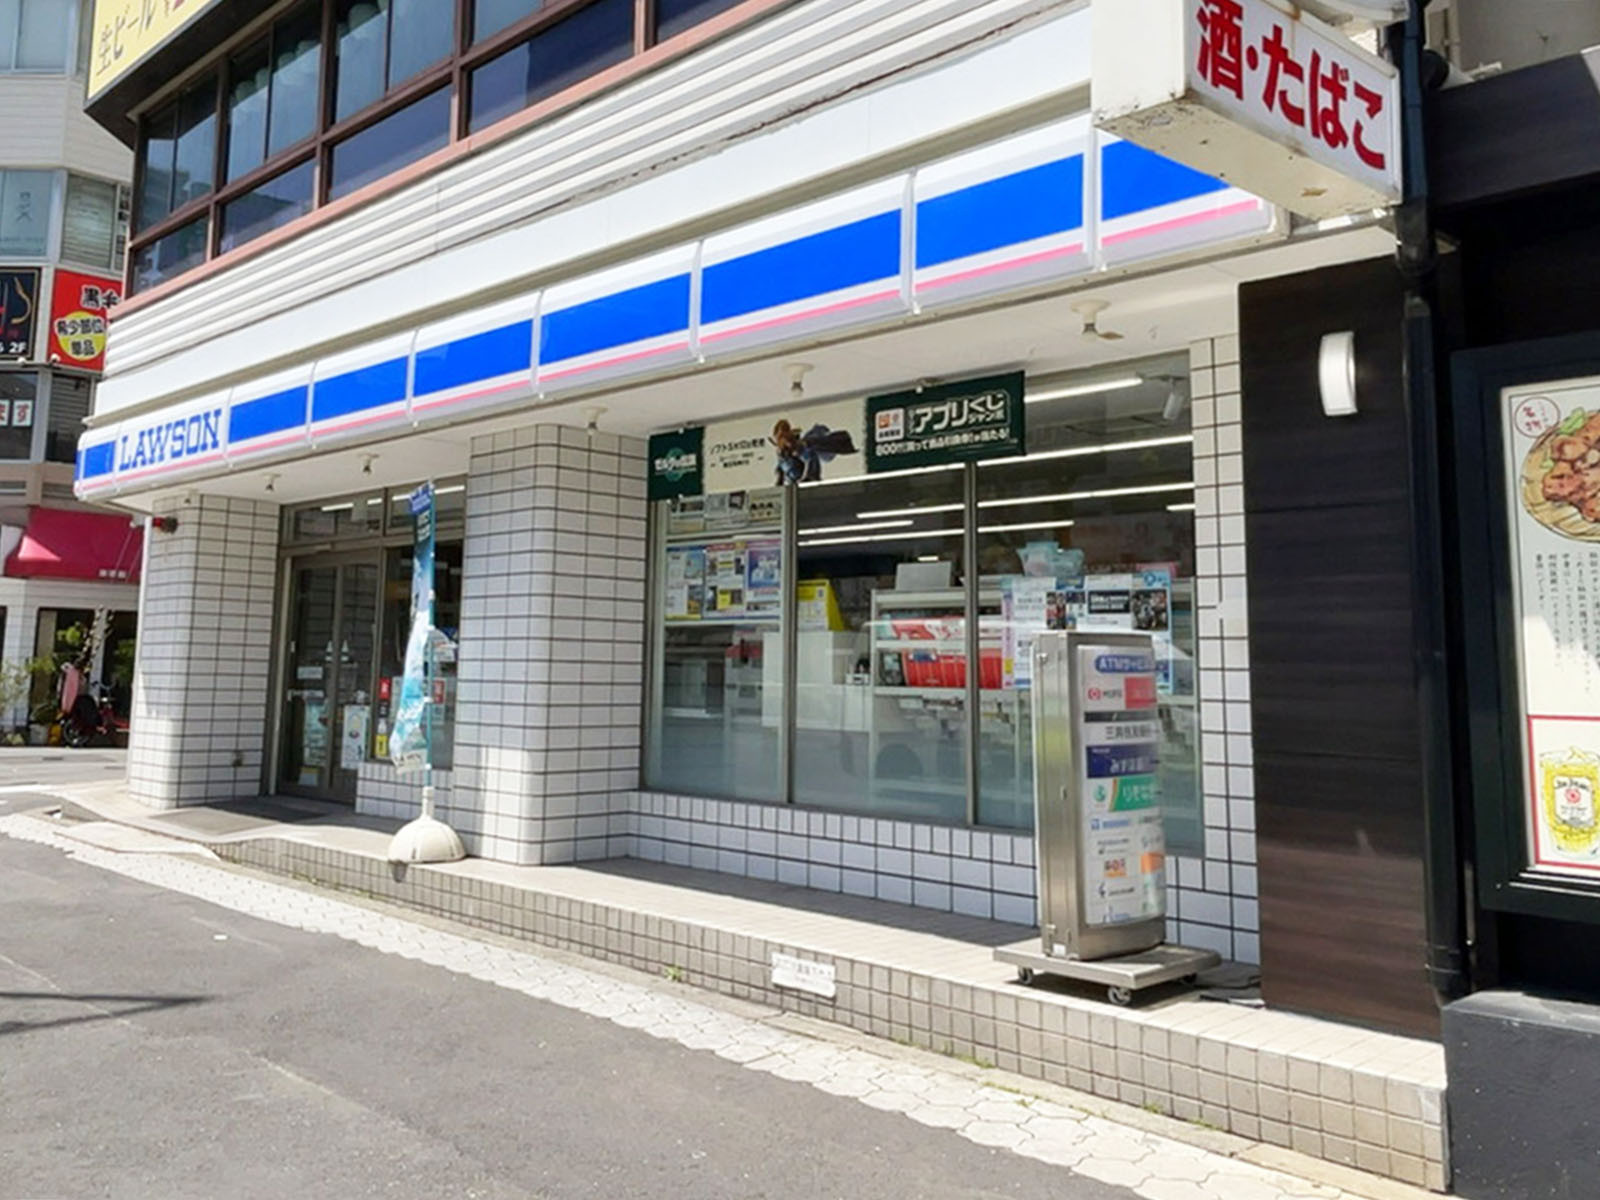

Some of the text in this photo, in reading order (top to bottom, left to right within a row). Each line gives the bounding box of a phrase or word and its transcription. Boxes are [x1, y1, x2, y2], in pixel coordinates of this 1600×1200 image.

[1196, 0, 1386, 170] 酒・たばこ
[9, 341, 27, 354] 2F
[119, 408, 222, 471] LAWSON
